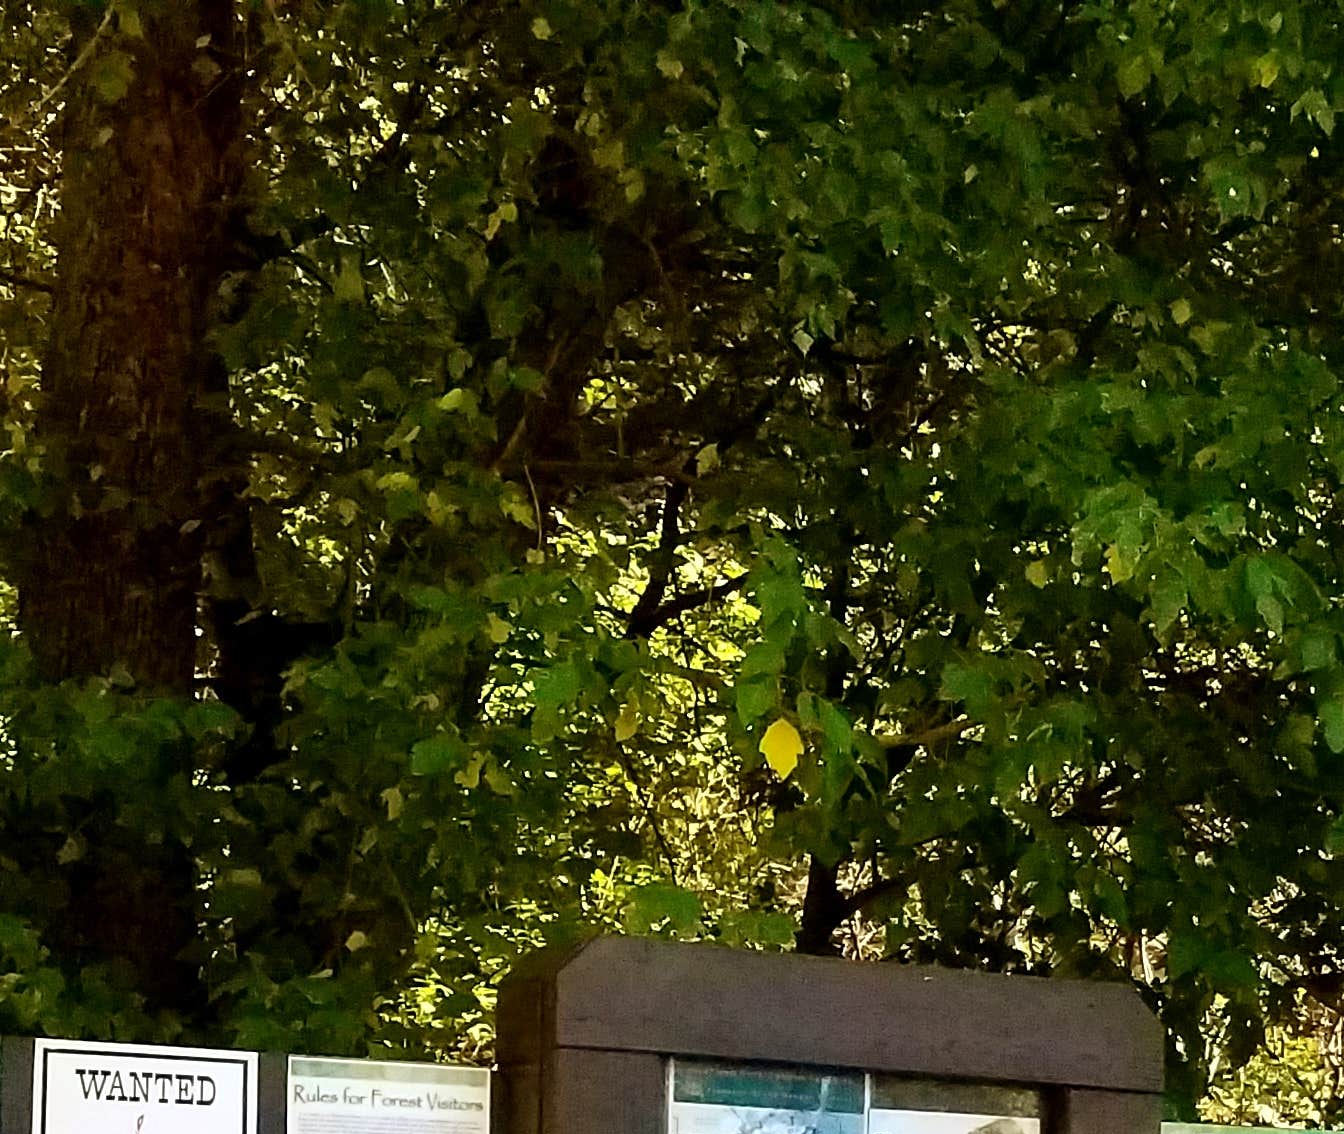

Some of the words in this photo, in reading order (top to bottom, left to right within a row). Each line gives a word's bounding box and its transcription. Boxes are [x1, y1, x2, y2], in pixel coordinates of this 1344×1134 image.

[75, 1069, 216, 1106] WANTED
[294, 1085, 338, 1103] Rules
[343, 1087, 365, 1105] for
[371, 1089, 422, 1108] Forest
[427, 1093, 484, 1112] Visitors
